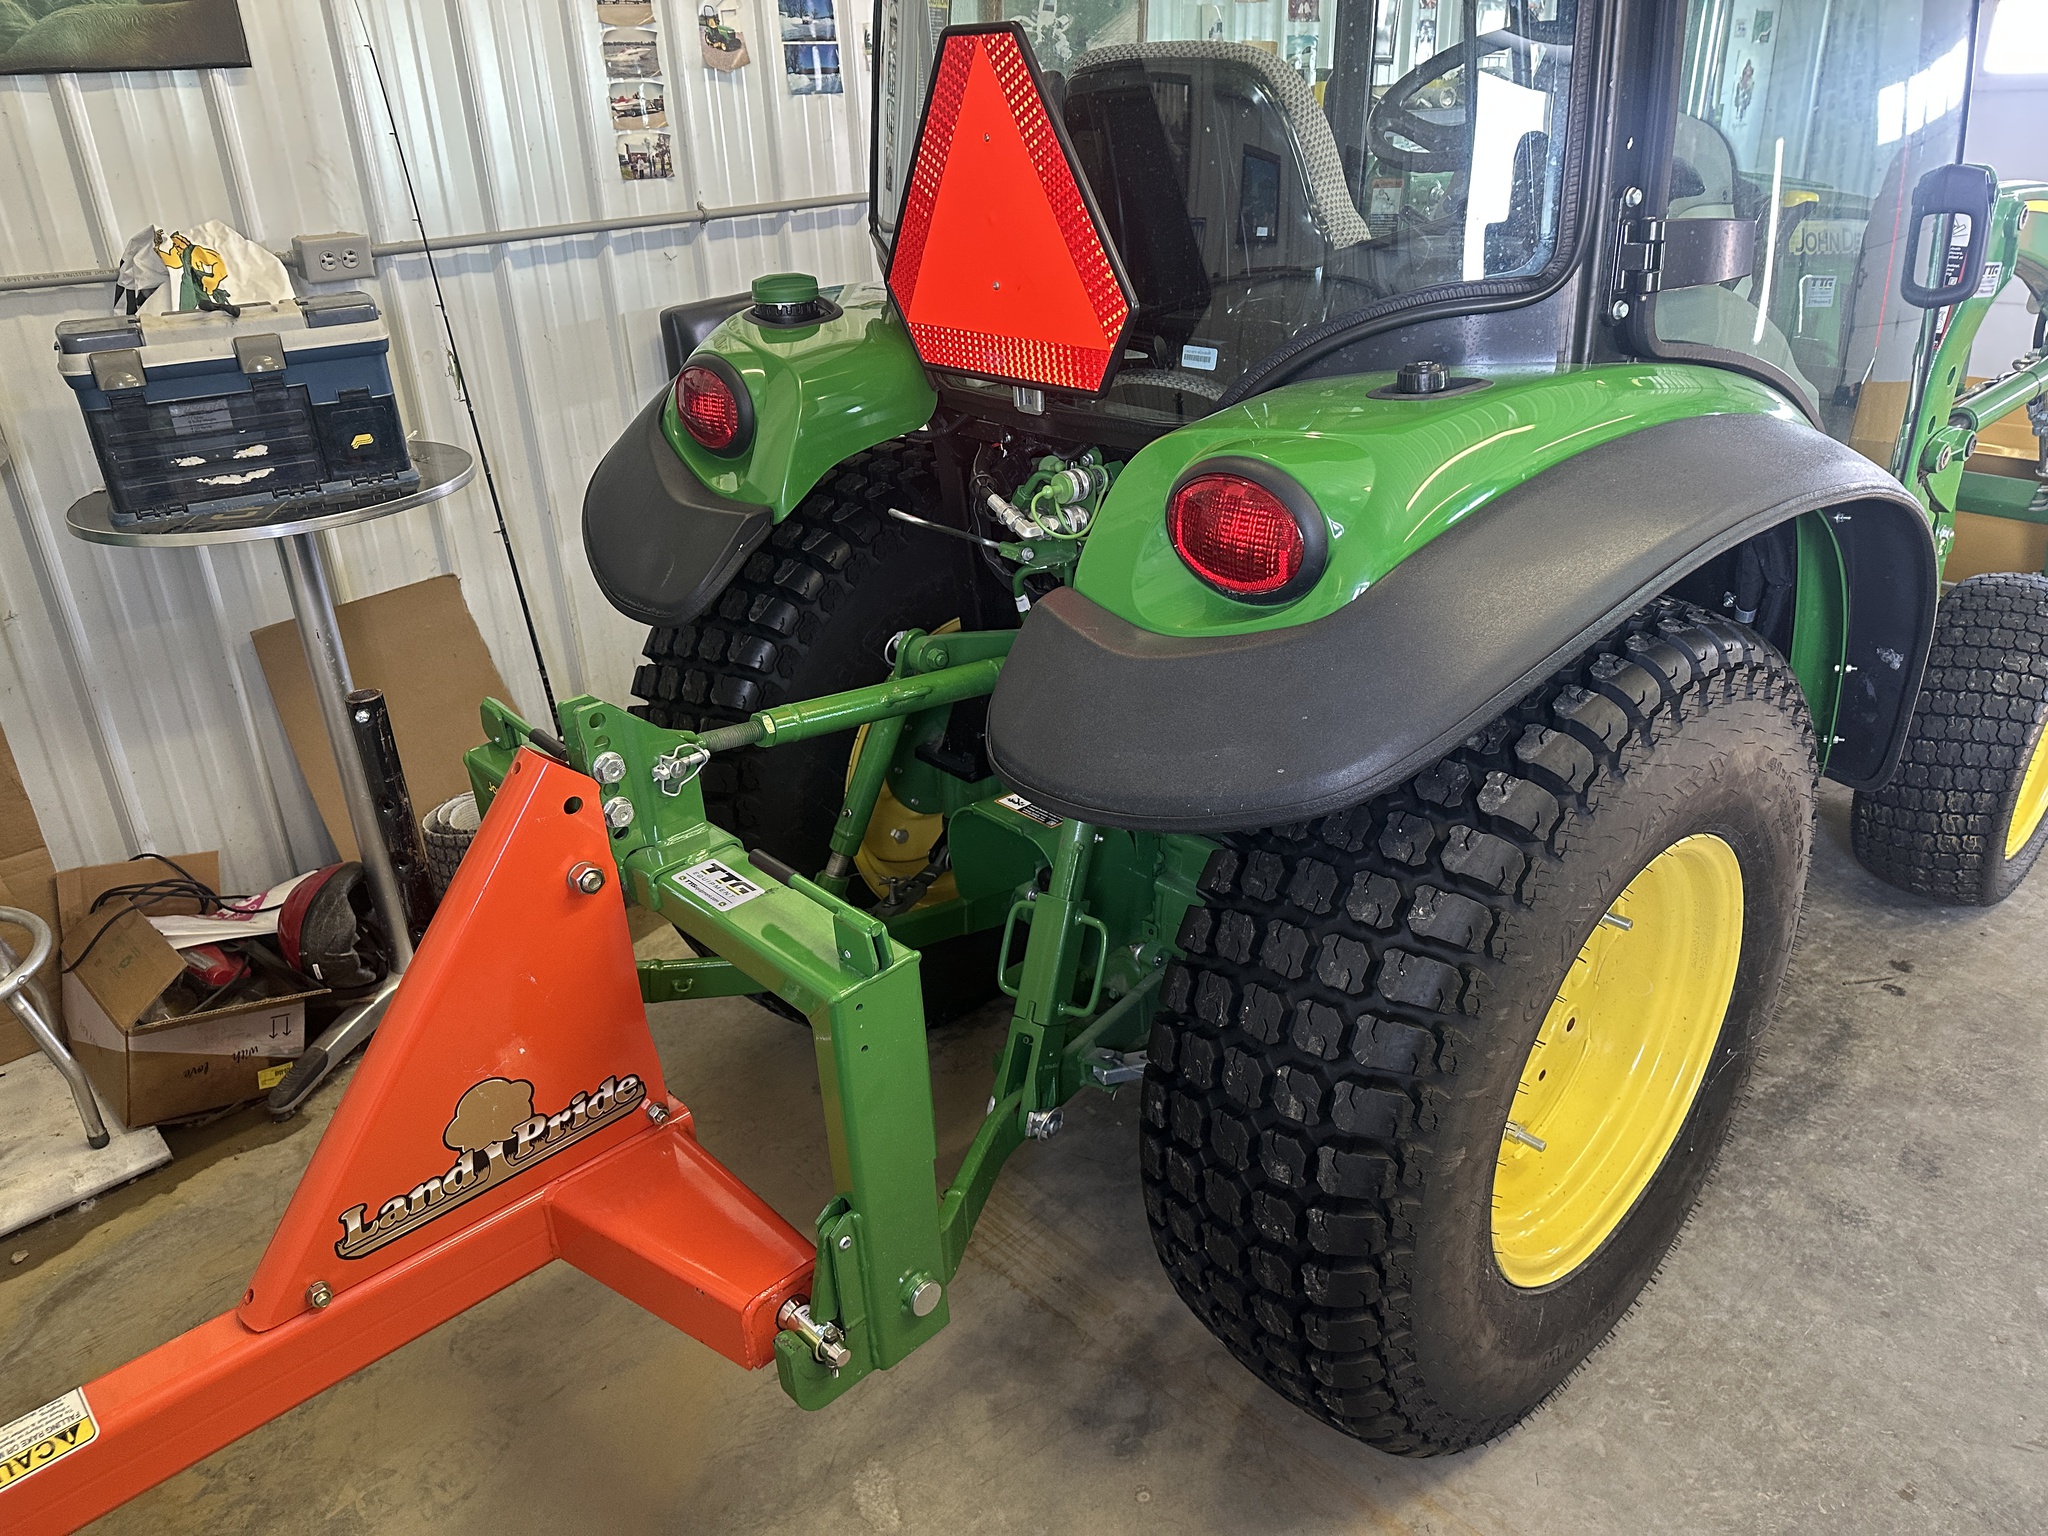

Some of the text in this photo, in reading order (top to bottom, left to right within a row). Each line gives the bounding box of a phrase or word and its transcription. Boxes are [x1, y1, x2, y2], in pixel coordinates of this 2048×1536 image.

[692, 871, 735, 899] EQUIPMENT
[701, 862, 757, 896] TTG
[232, 1046, 259, 1063] with
[184, 1062, 209, 1079] love
[341, 1074, 641, 1248] Land Pride
[44, 1410, 81, 1434] FALLING
[19, 1430, 45, 1447] RAKE
